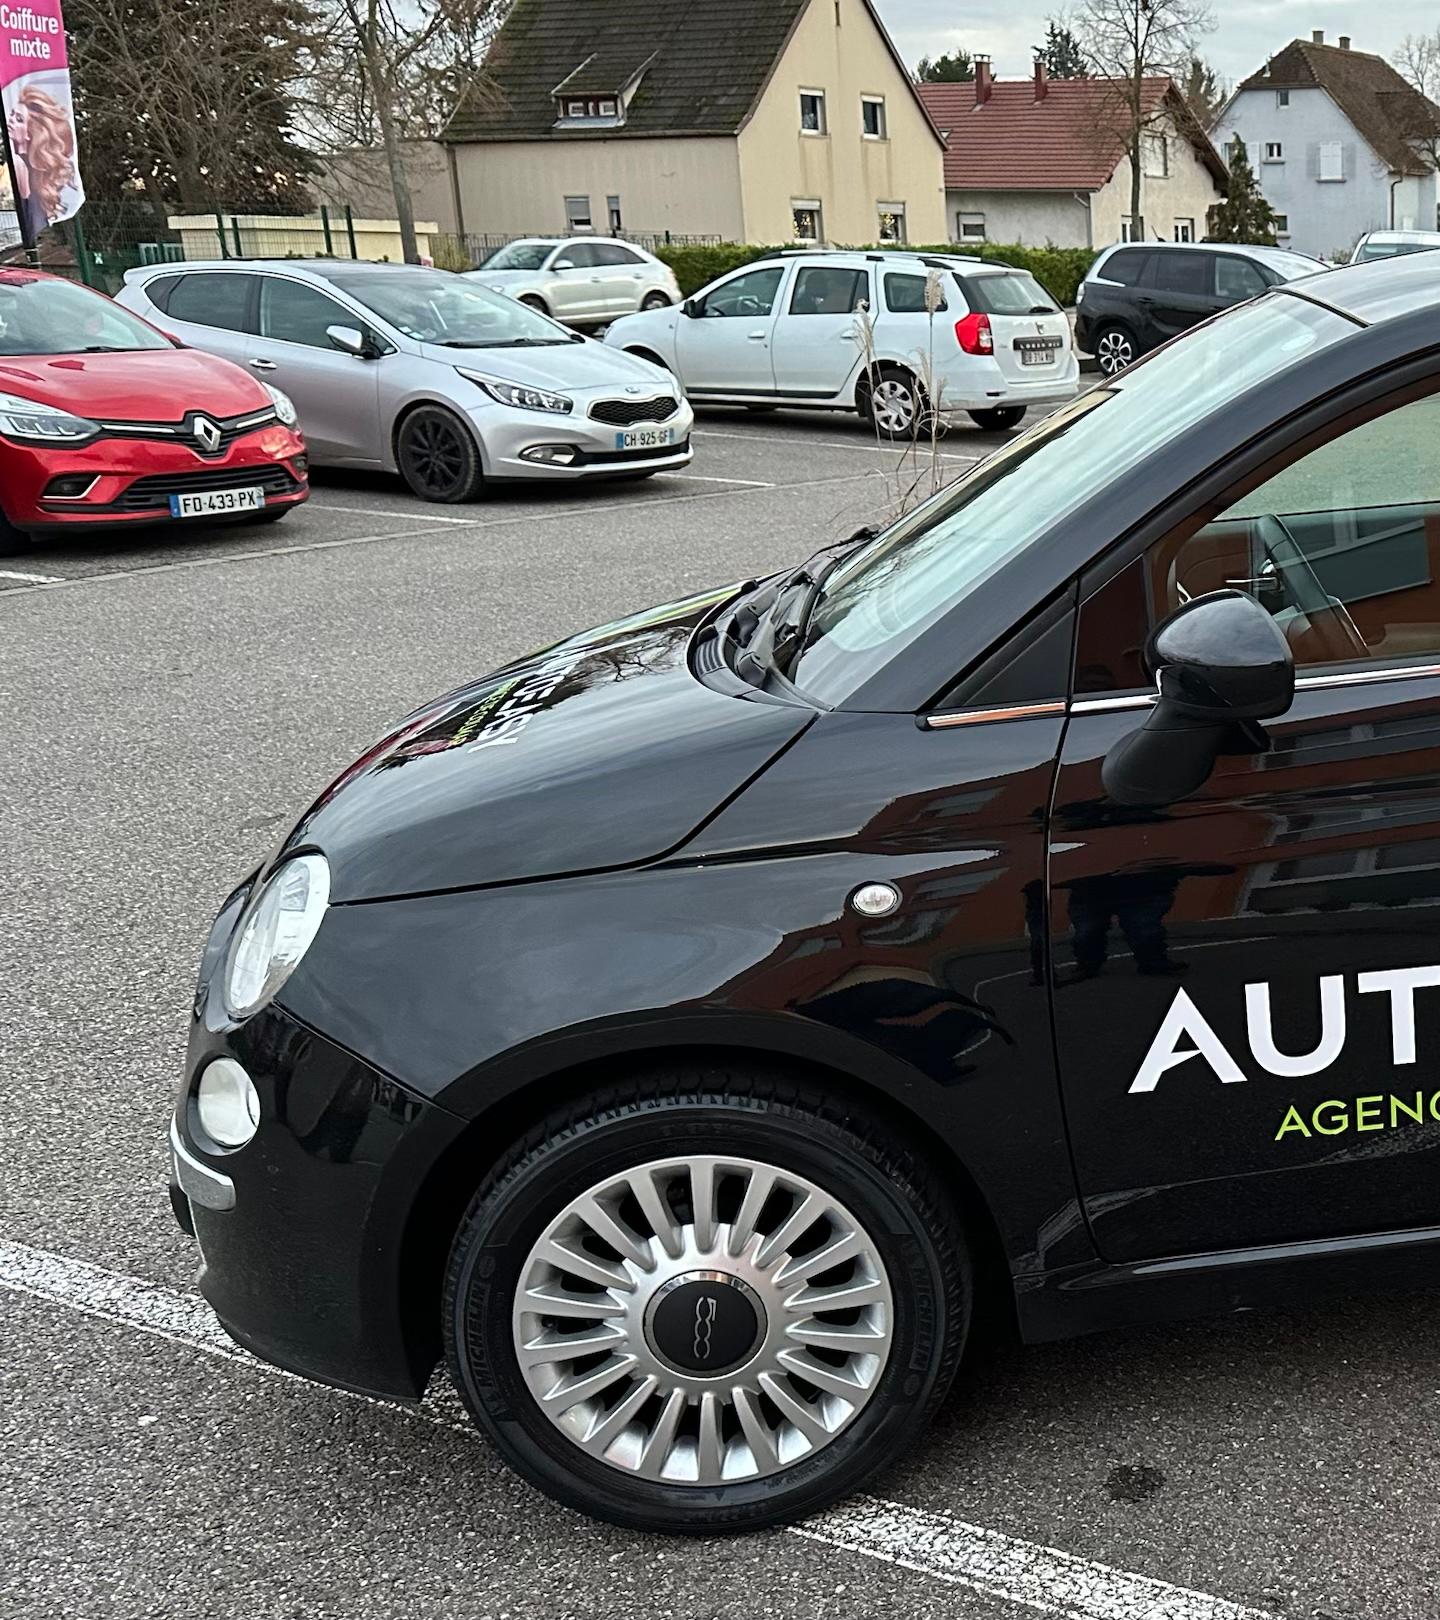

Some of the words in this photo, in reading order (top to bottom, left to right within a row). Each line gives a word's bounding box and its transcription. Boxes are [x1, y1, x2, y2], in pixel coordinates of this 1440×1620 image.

[0, 4, 59, 35] Coiffure
[10, 33, 51, 60] mixte
[182, 490, 256, 513] FD-433-PX
